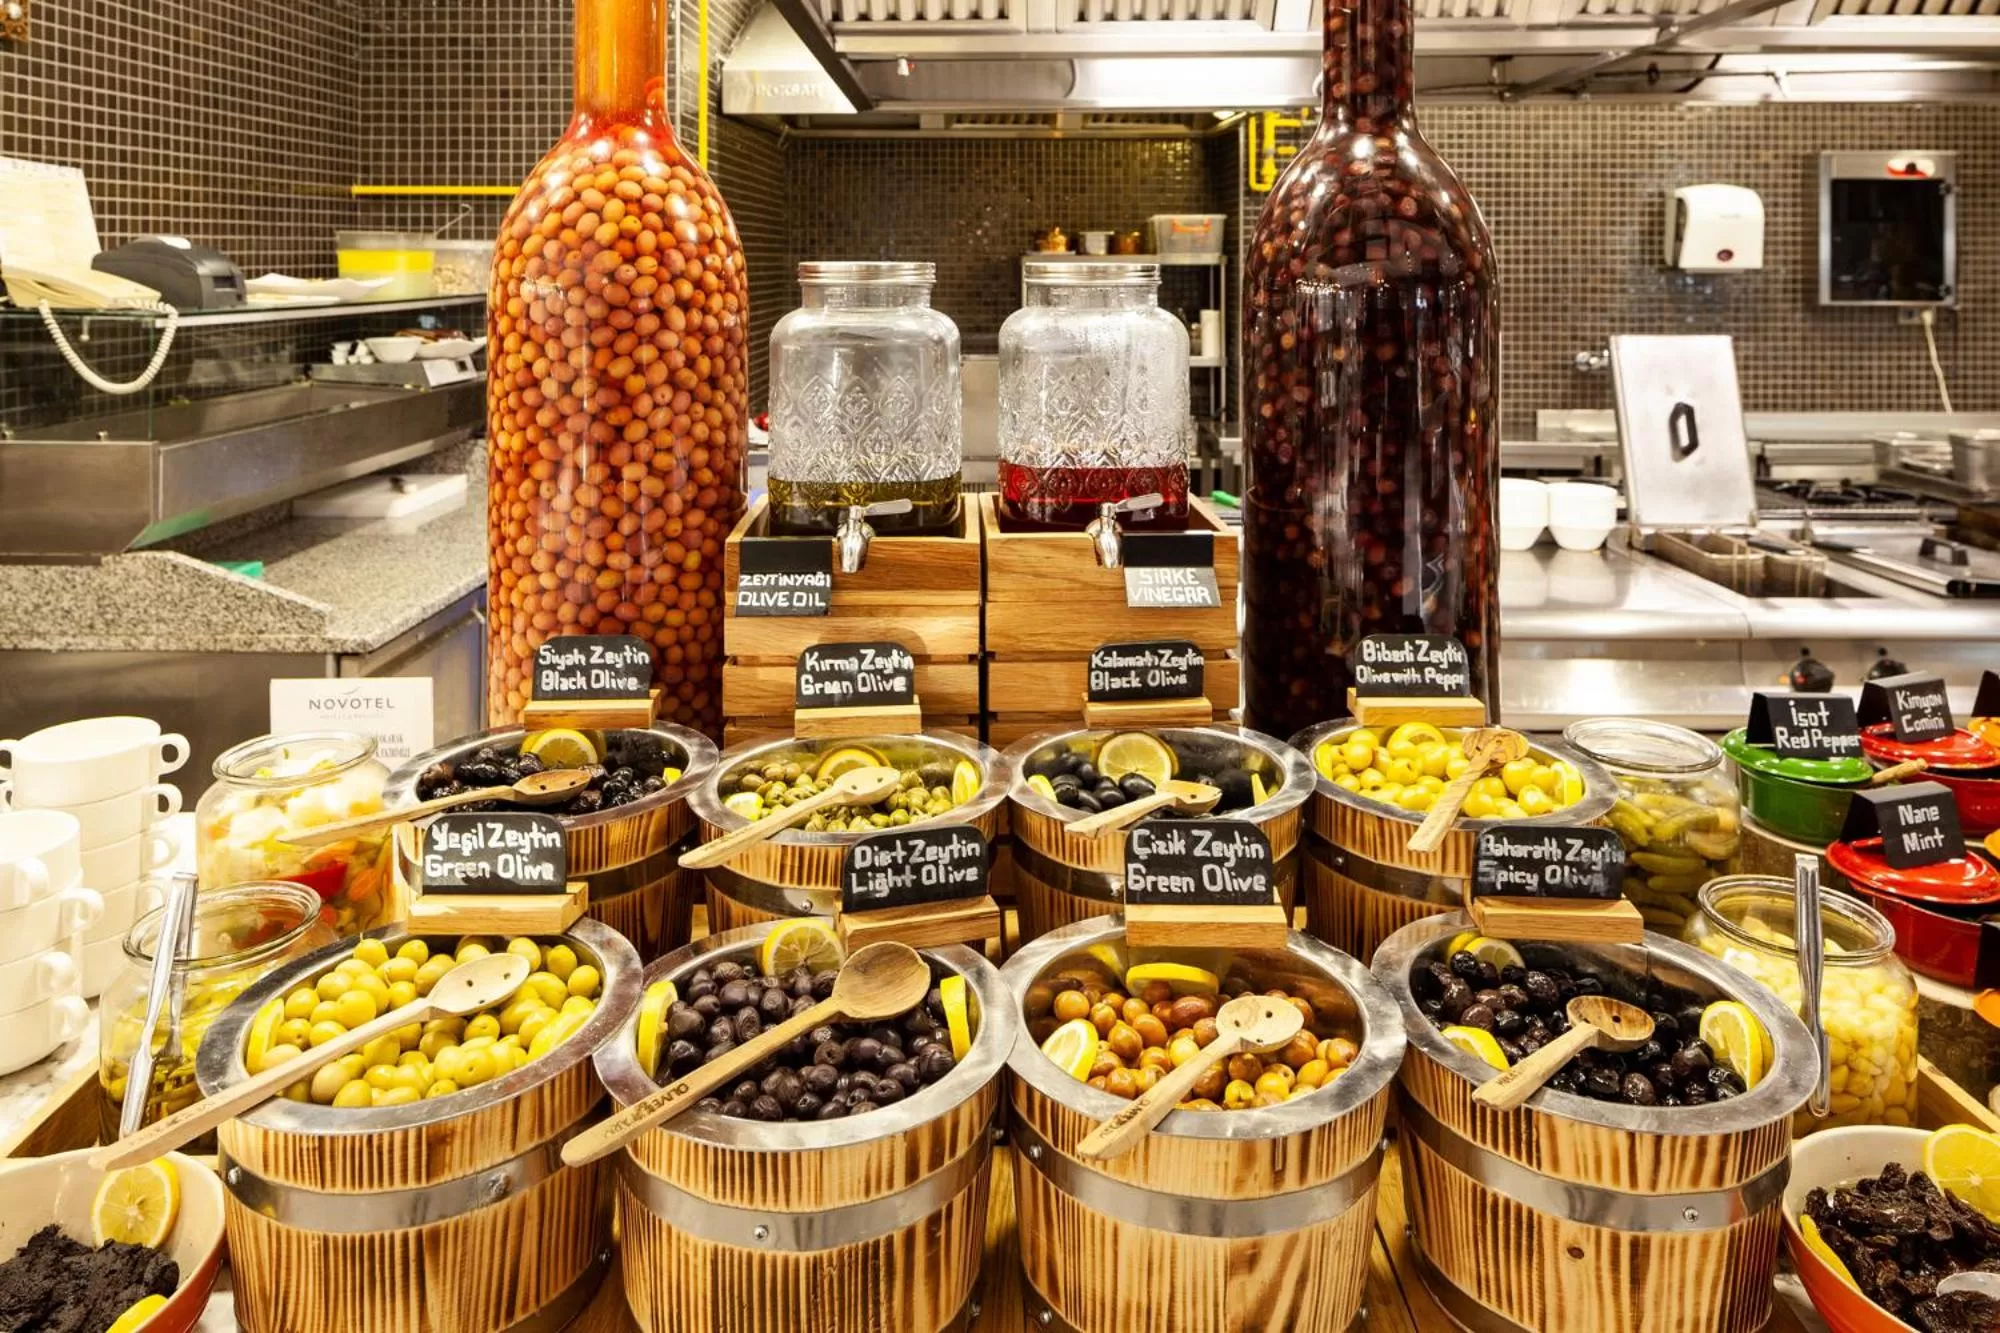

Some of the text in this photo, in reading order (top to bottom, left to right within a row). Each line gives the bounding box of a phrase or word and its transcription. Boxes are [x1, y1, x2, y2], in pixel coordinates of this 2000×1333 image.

[738, 591, 827, 607] OLIVE OIL
[1128, 586, 1213, 605] VINEGAR
[539, 645, 650, 671] Siyah Zeytin
[859, 649, 914, 675] Zeytin
[1157, 648, 1204, 671] Zeytin
[541, 669, 639, 691] Black Olive
[801, 672, 907, 695] Green Olive
[1090, 669, 1188, 692] Black Olive
[309, 698, 395, 710] NOVOTEL
[1775, 727, 1810, 749] Red
[1898, 804, 1940, 826] Nane
[486, 821, 562, 854] Zeytin
[1132, 828, 1265, 867] Çizik Zeytin
[1902, 827, 1945, 854] Mint
[854, 833, 981, 869] Diet Zeytin
[1565, 838, 1625, 871] Zeytin
[424, 854, 555, 880] Green Olive
[1127, 863, 1266, 893] Green Olive
[1477, 859, 1539, 891] Spicy
[851, 863, 978, 898] Light Olive
